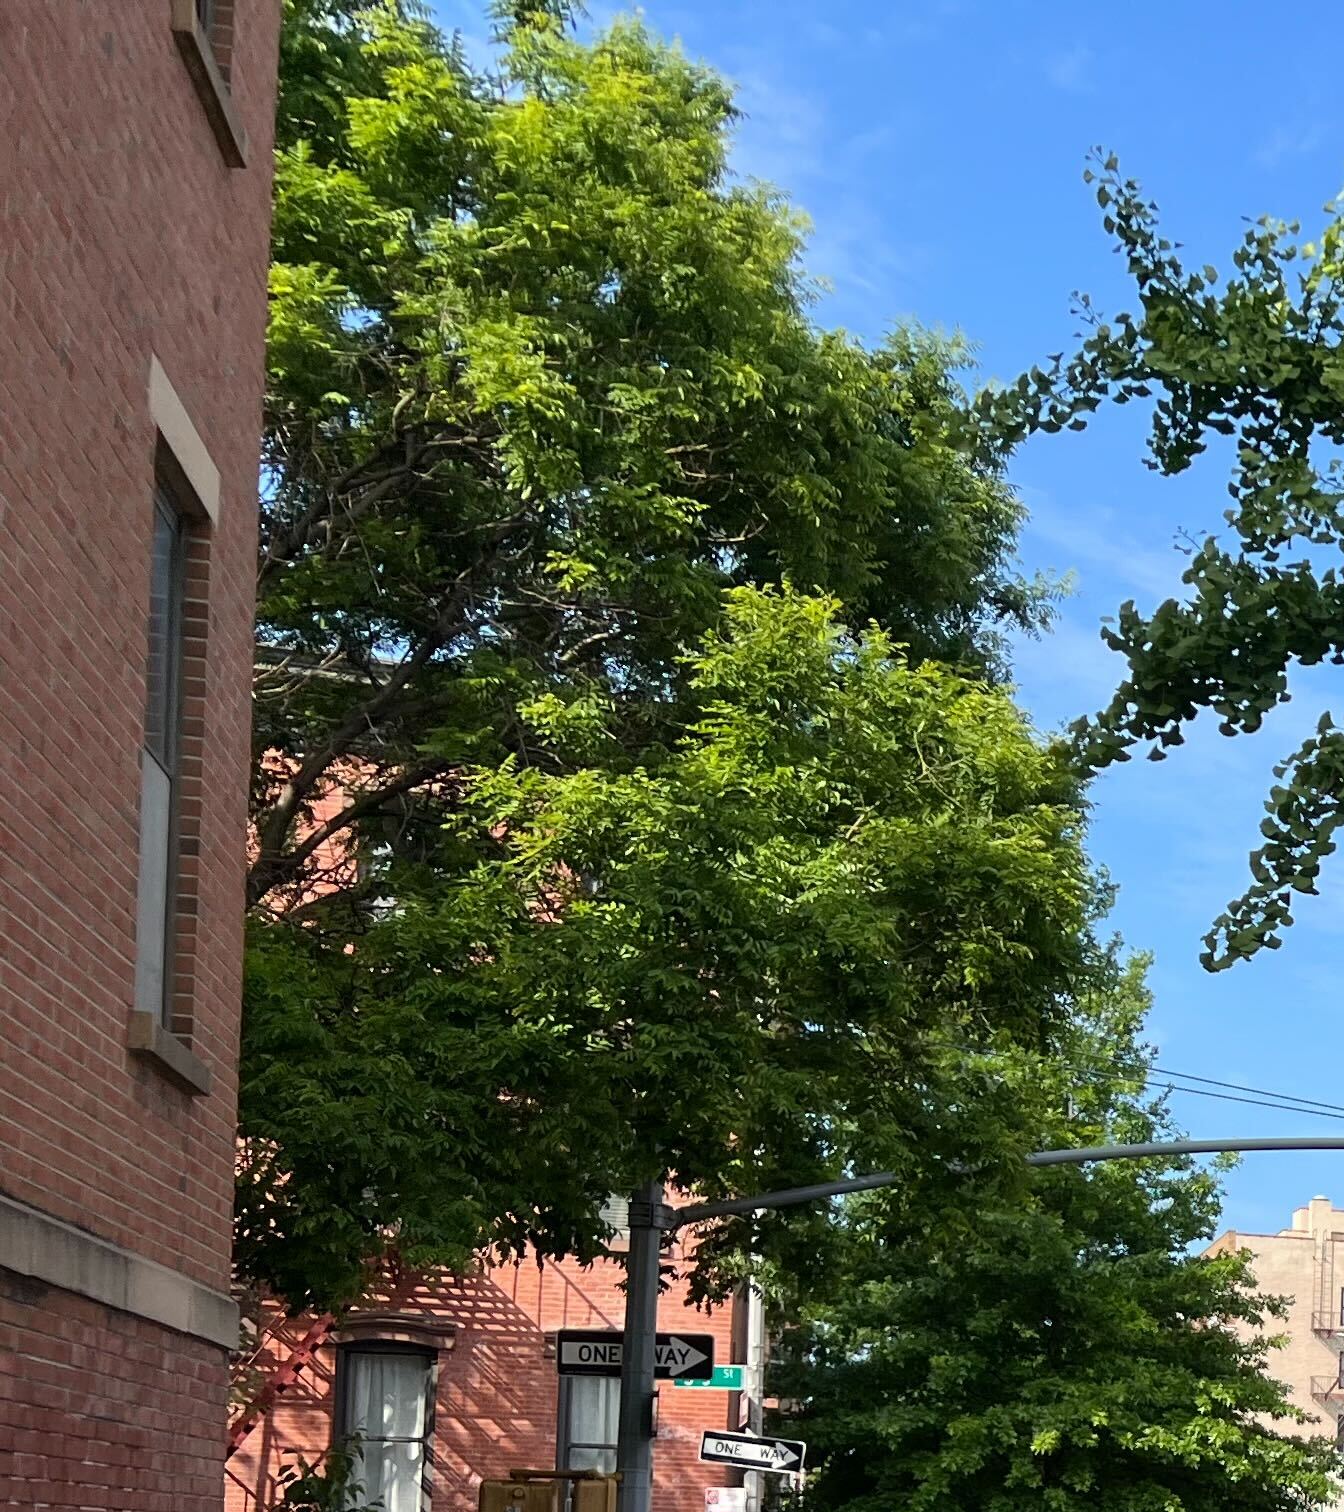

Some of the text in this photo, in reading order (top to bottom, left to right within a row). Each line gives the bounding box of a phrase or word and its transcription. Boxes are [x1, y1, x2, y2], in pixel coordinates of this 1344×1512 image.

[578, 1345, 621, 1363] ONE
[723, 1368, 734, 1379] St
[715, 1441, 789, 1462] ONE WAY
